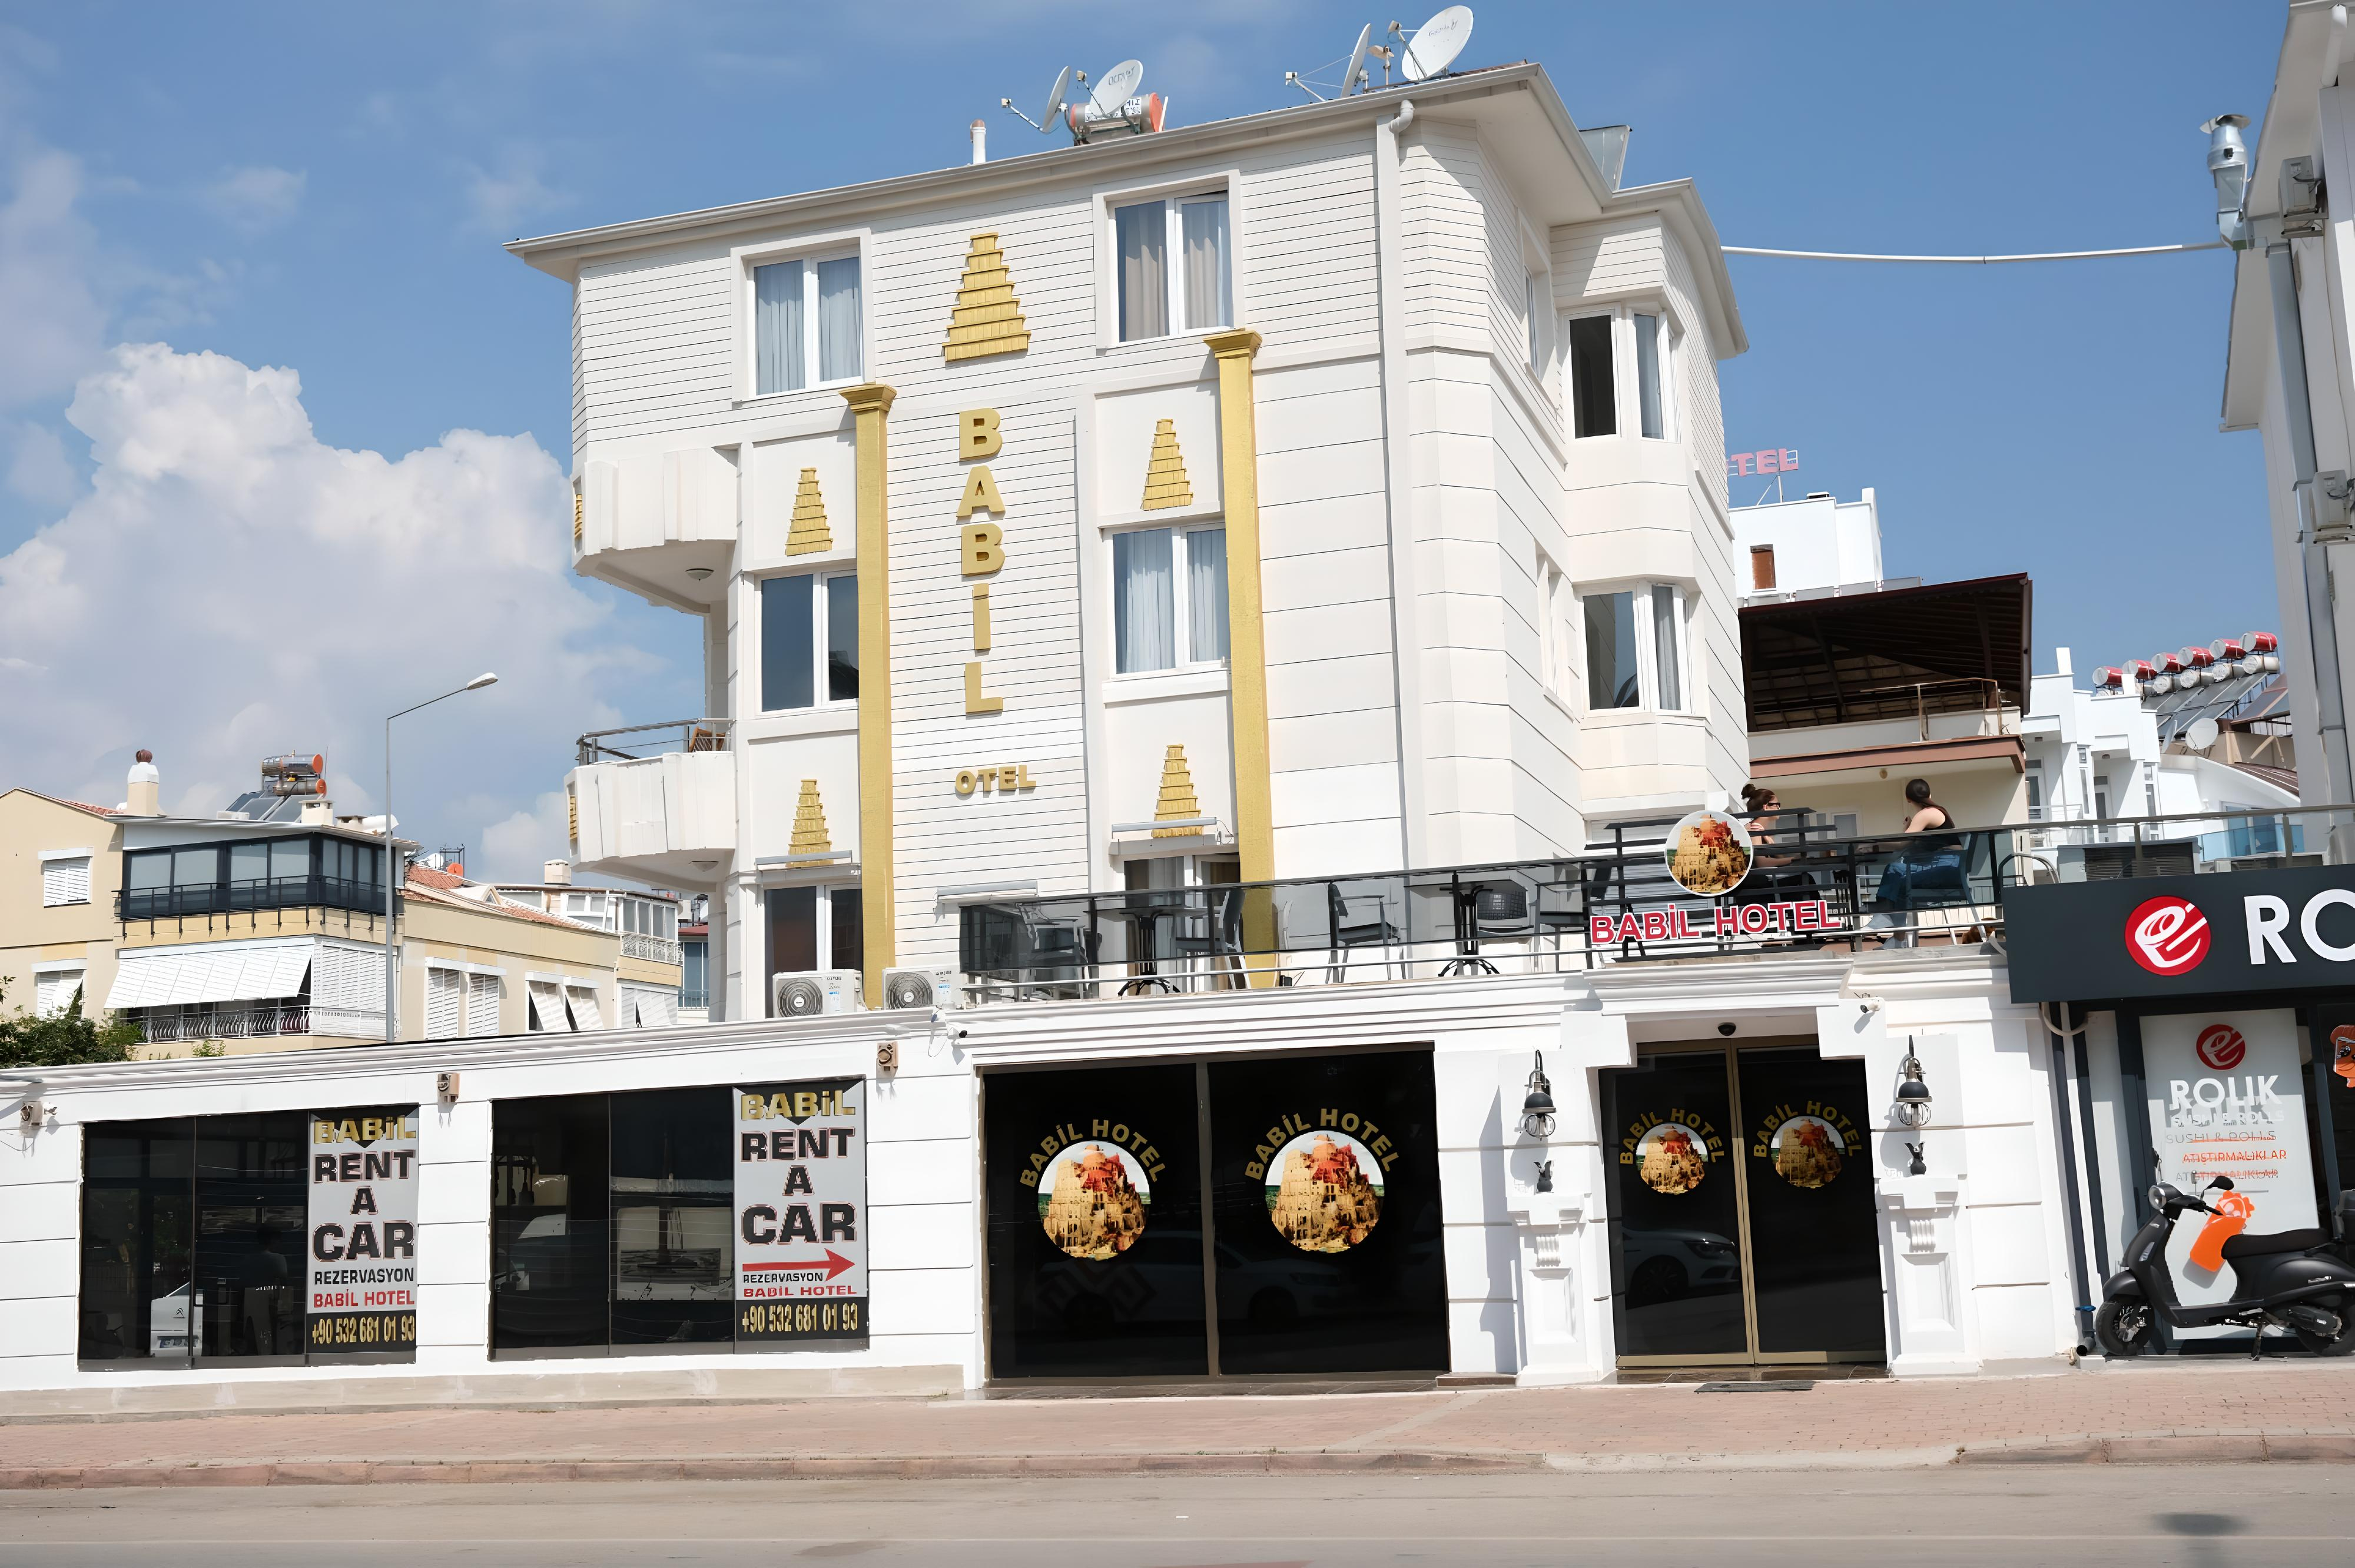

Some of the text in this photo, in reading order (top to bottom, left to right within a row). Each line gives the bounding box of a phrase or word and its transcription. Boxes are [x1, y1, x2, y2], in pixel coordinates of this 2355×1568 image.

[1727, 448, 1799, 476] TEL
[955, 765, 1036, 795] OTEL
[1714, 899, 1842, 936] HOTEL
[2170, 1075, 2283, 1110] ROLIK
[741, 1127, 855, 1162] RENT
[1319, 1108, 1401, 1172] HOTEL
[1670, 1108, 1724, 1163] HOTEL
[1806, 1100, 1862, 1157] HOTEL
[313, 1150, 416, 1183] RENT
[1092, 1119, 1166, 1182] HOTEL
[782, 1165, 815, 1196] A
[350, 1185, 378, 1215] A
[741, 1201, 857, 1245] CAR
[313, 1220, 415, 1262] CAR
[314, 1268, 413, 1284] REZERVASYON
[801, 1285, 857, 1295] HOTEL
[364, 1290, 414, 1305] HOTEL
[312, 1315, 414, 1344] +90 532 681 01 93
[742, 1303, 857, 1333] +90 532 681 01 93
